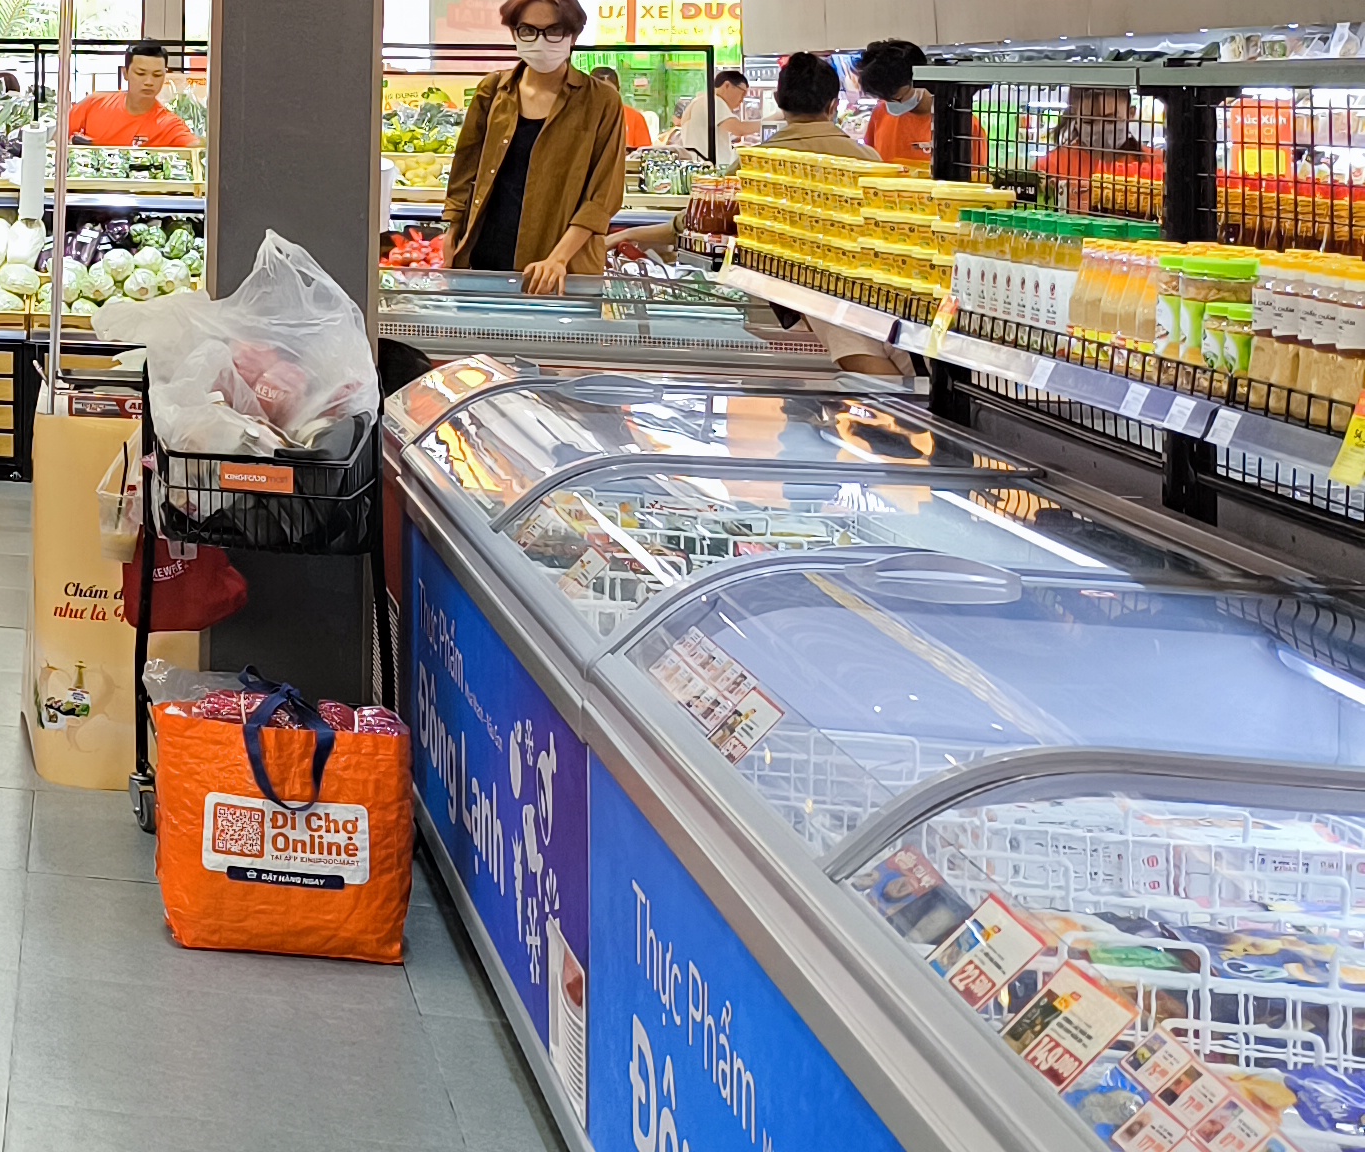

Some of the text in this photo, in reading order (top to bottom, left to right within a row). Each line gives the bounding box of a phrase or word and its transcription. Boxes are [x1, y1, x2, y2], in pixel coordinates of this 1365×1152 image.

[641, 5, 669, 19] XE
[64, 582, 109, 599] Chấm
[54, 602, 108, 621] như là
[418, 577, 464, 693] Thực Phẩm
[418, 660, 457, 824] Đông
[461, 731, 504, 897] Lạnh
[270, 811, 358, 837] Đi Chợ
[272, 832, 358, 857] Online
[631, 879, 756, 1144] Thực Phẩm
[629, 1013, 690, 1152] Đô
